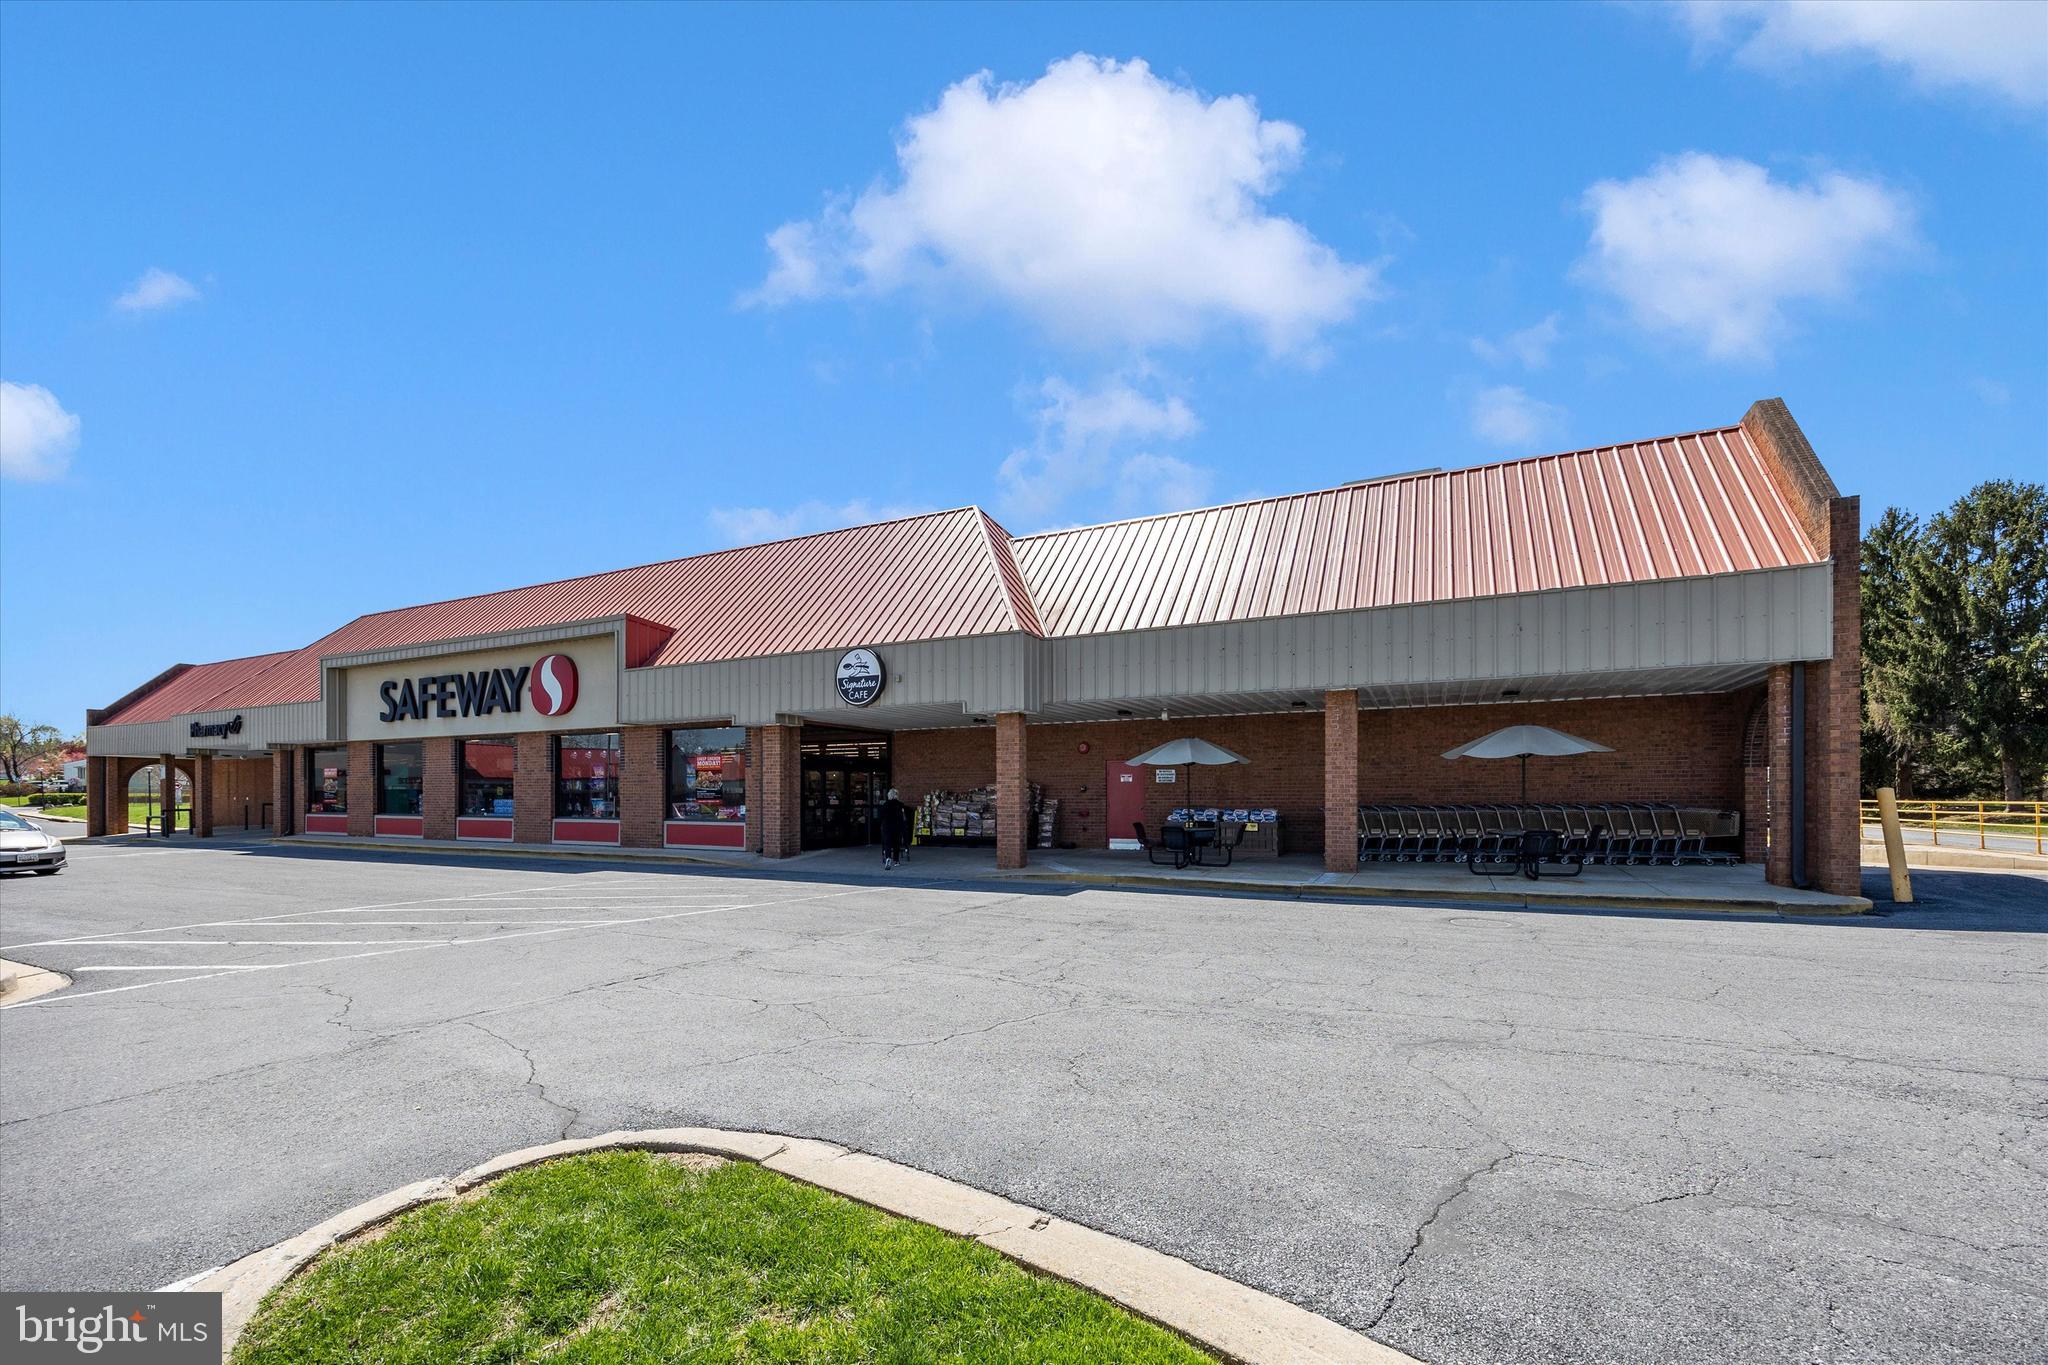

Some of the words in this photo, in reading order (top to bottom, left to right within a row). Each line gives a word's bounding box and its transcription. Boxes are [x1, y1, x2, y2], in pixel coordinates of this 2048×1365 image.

[841, 678, 877, 692] Signature
[380, 666, 530, 722] SAFEWAY
[848, 690, 868, 700] CAFE
[190, 721, 229, 739] Pharmacy
